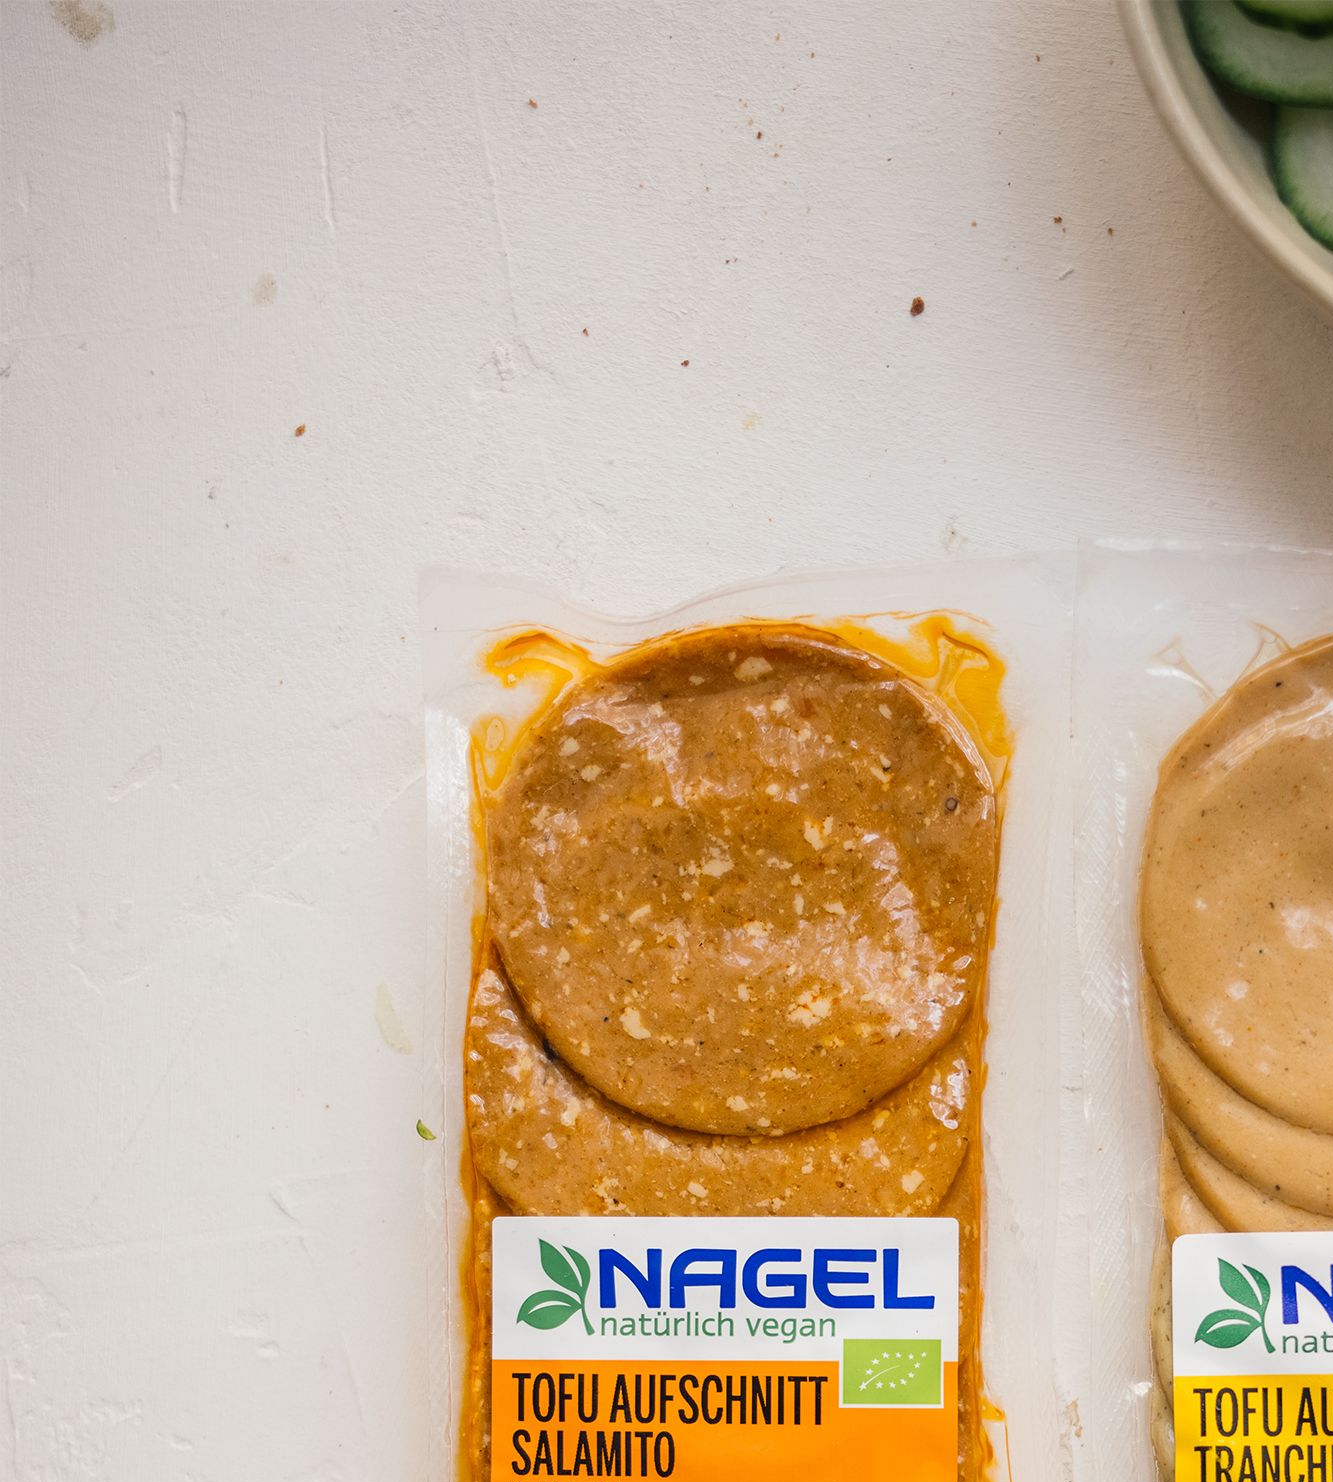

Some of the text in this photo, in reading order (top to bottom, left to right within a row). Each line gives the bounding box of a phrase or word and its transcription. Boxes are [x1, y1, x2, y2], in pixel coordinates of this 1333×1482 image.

[599, 1248, 935, 1309] NAGEL
[601, 1312, 836, 1343] natürlich vegan
[512, 1373, 827, 1425] TOFU AUFSCHNITT
[1193, 1388, 1282, 1436] TOFU
[511, 1430, 675, 1478] SALAMITO
